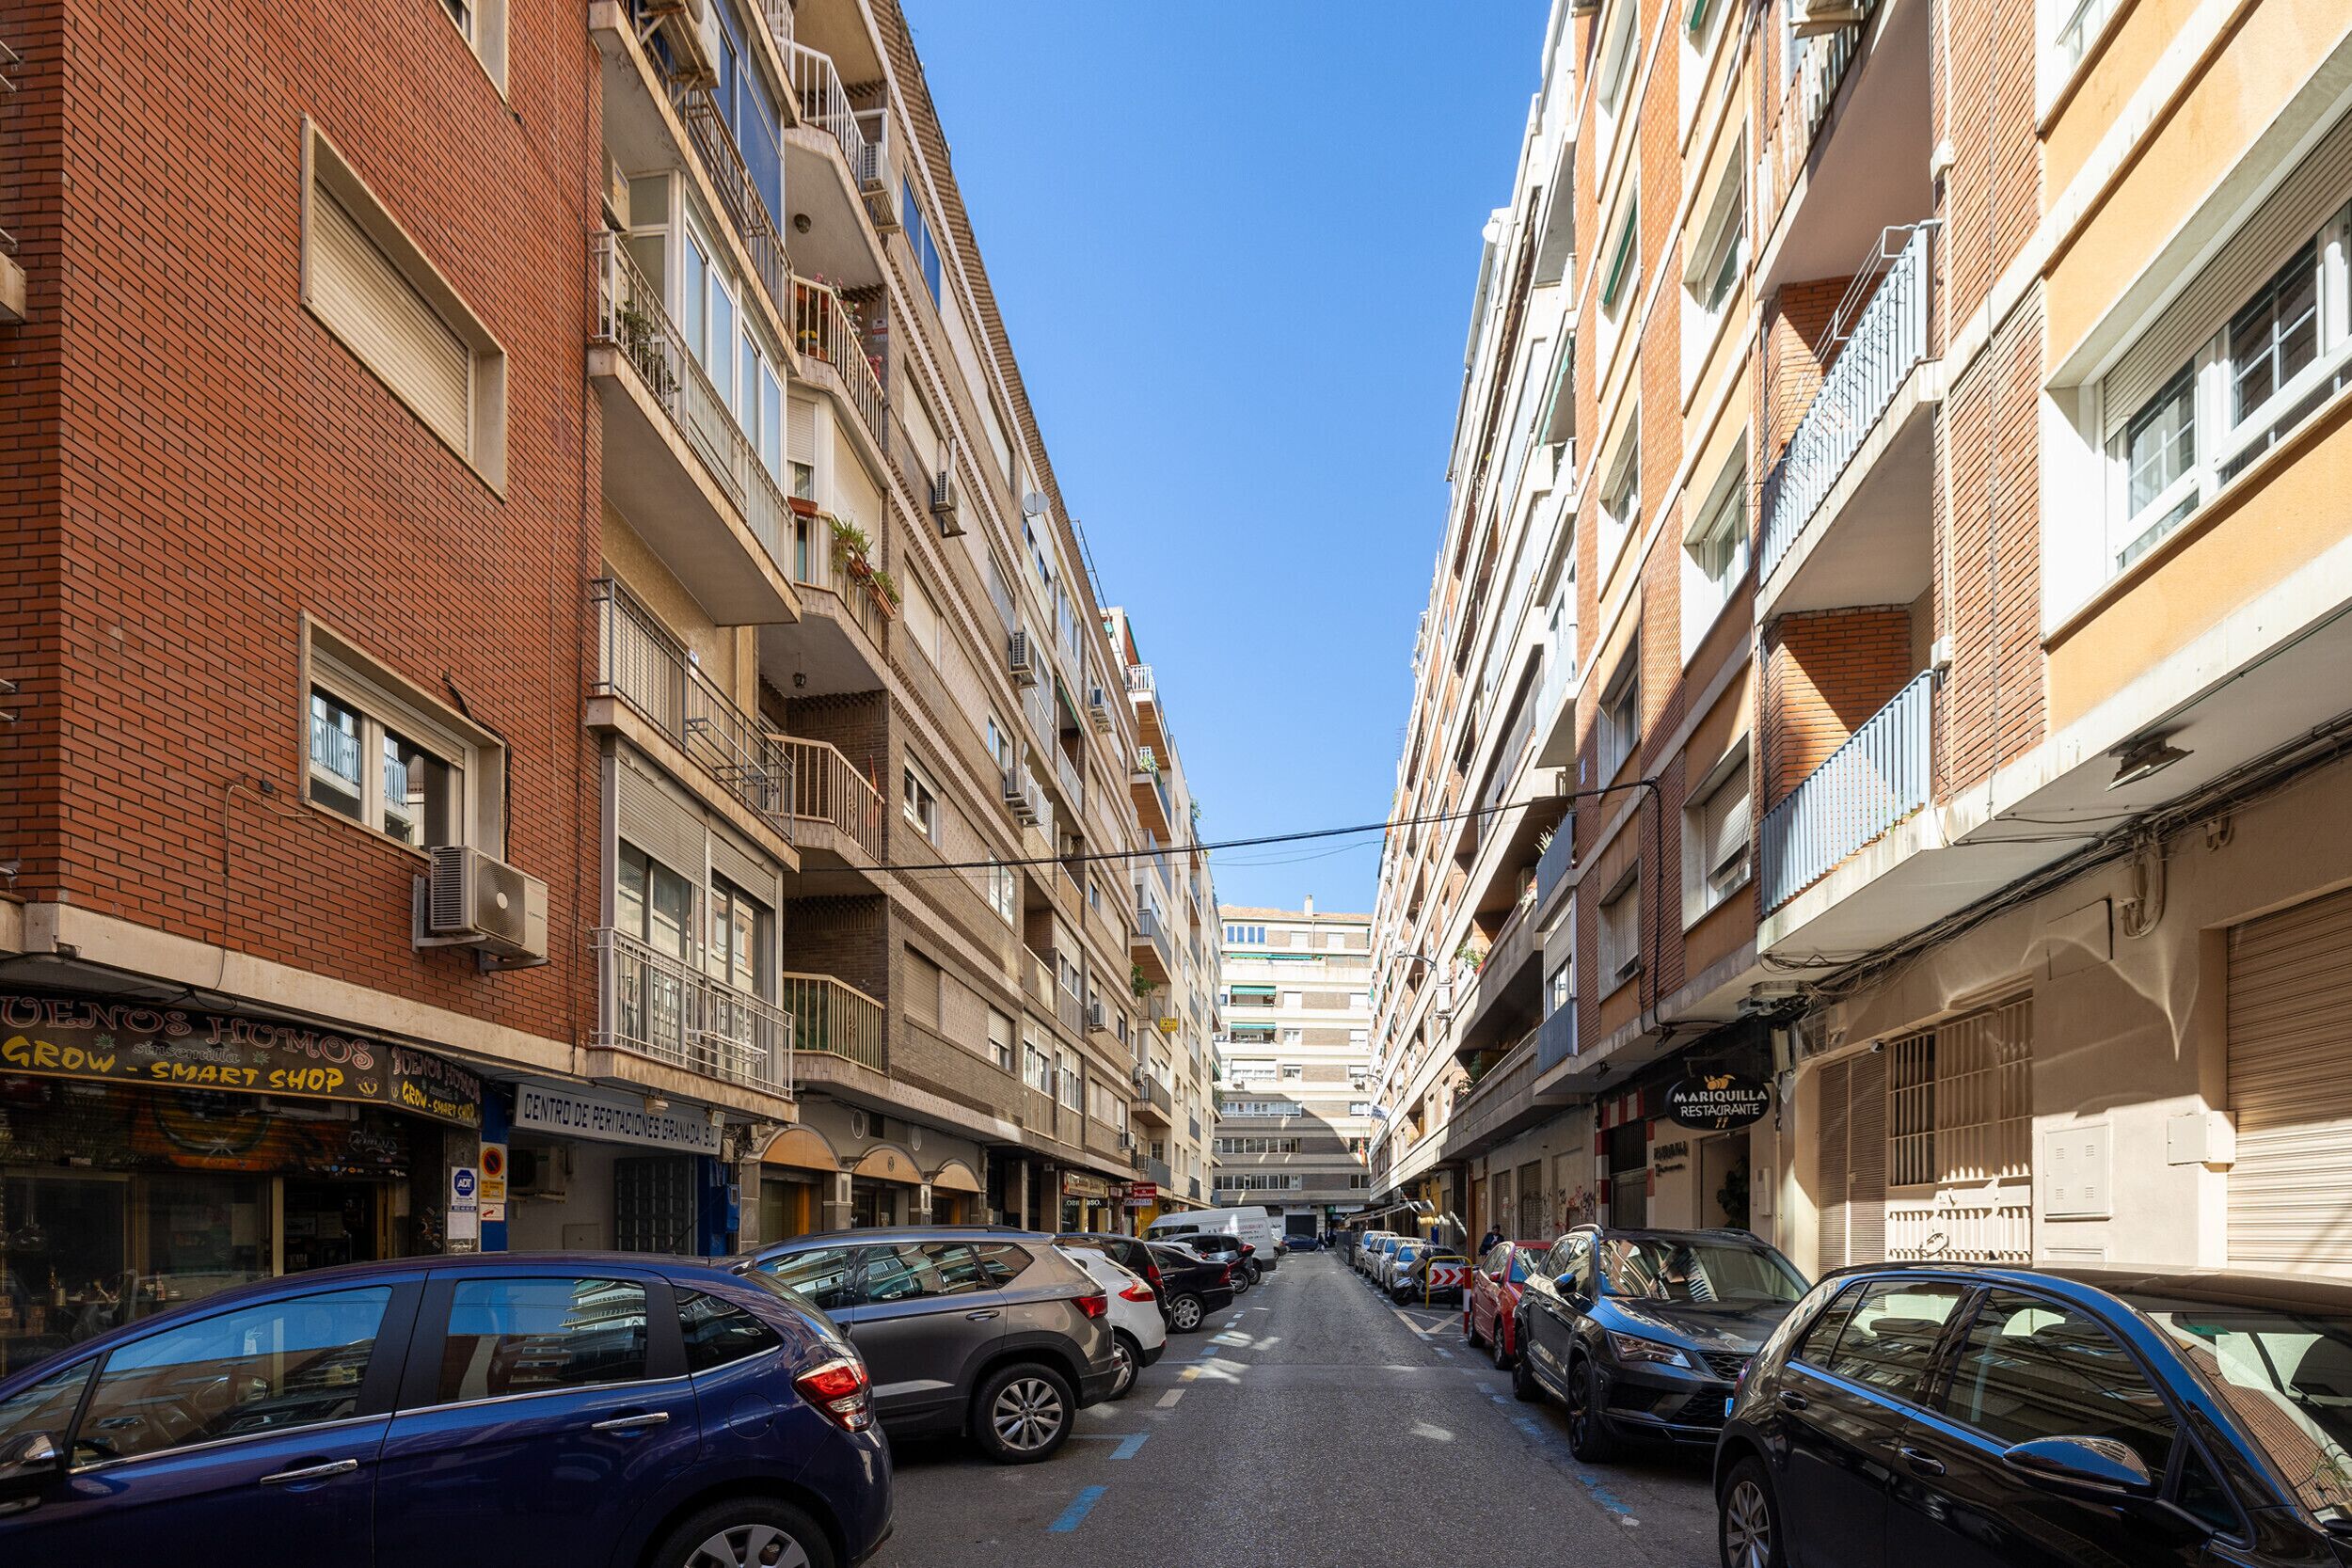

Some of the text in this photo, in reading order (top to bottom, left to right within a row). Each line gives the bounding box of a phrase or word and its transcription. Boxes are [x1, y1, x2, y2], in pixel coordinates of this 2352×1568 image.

[0, 996, 374, 1070] UENOS HUMOS
[1, 1036, 116, 1073] GROW
[151, 1061, 260, 1087] SMART
[268, 1068, 344, 1093] SHOP
[402, 1080, 427, 1108] GROW
[1673, 1090, 1768, 1102] MARIQUILLA
[525, 1093, 571, 1125] CENTRO
[574, 1102, 589, 1128] DE
[592, 1105, 660, 1139] PERITACIONES
[1680, 1103, 1760, 1117] RESTAURANTE
[457, 1179, 471, 1189] ADT
